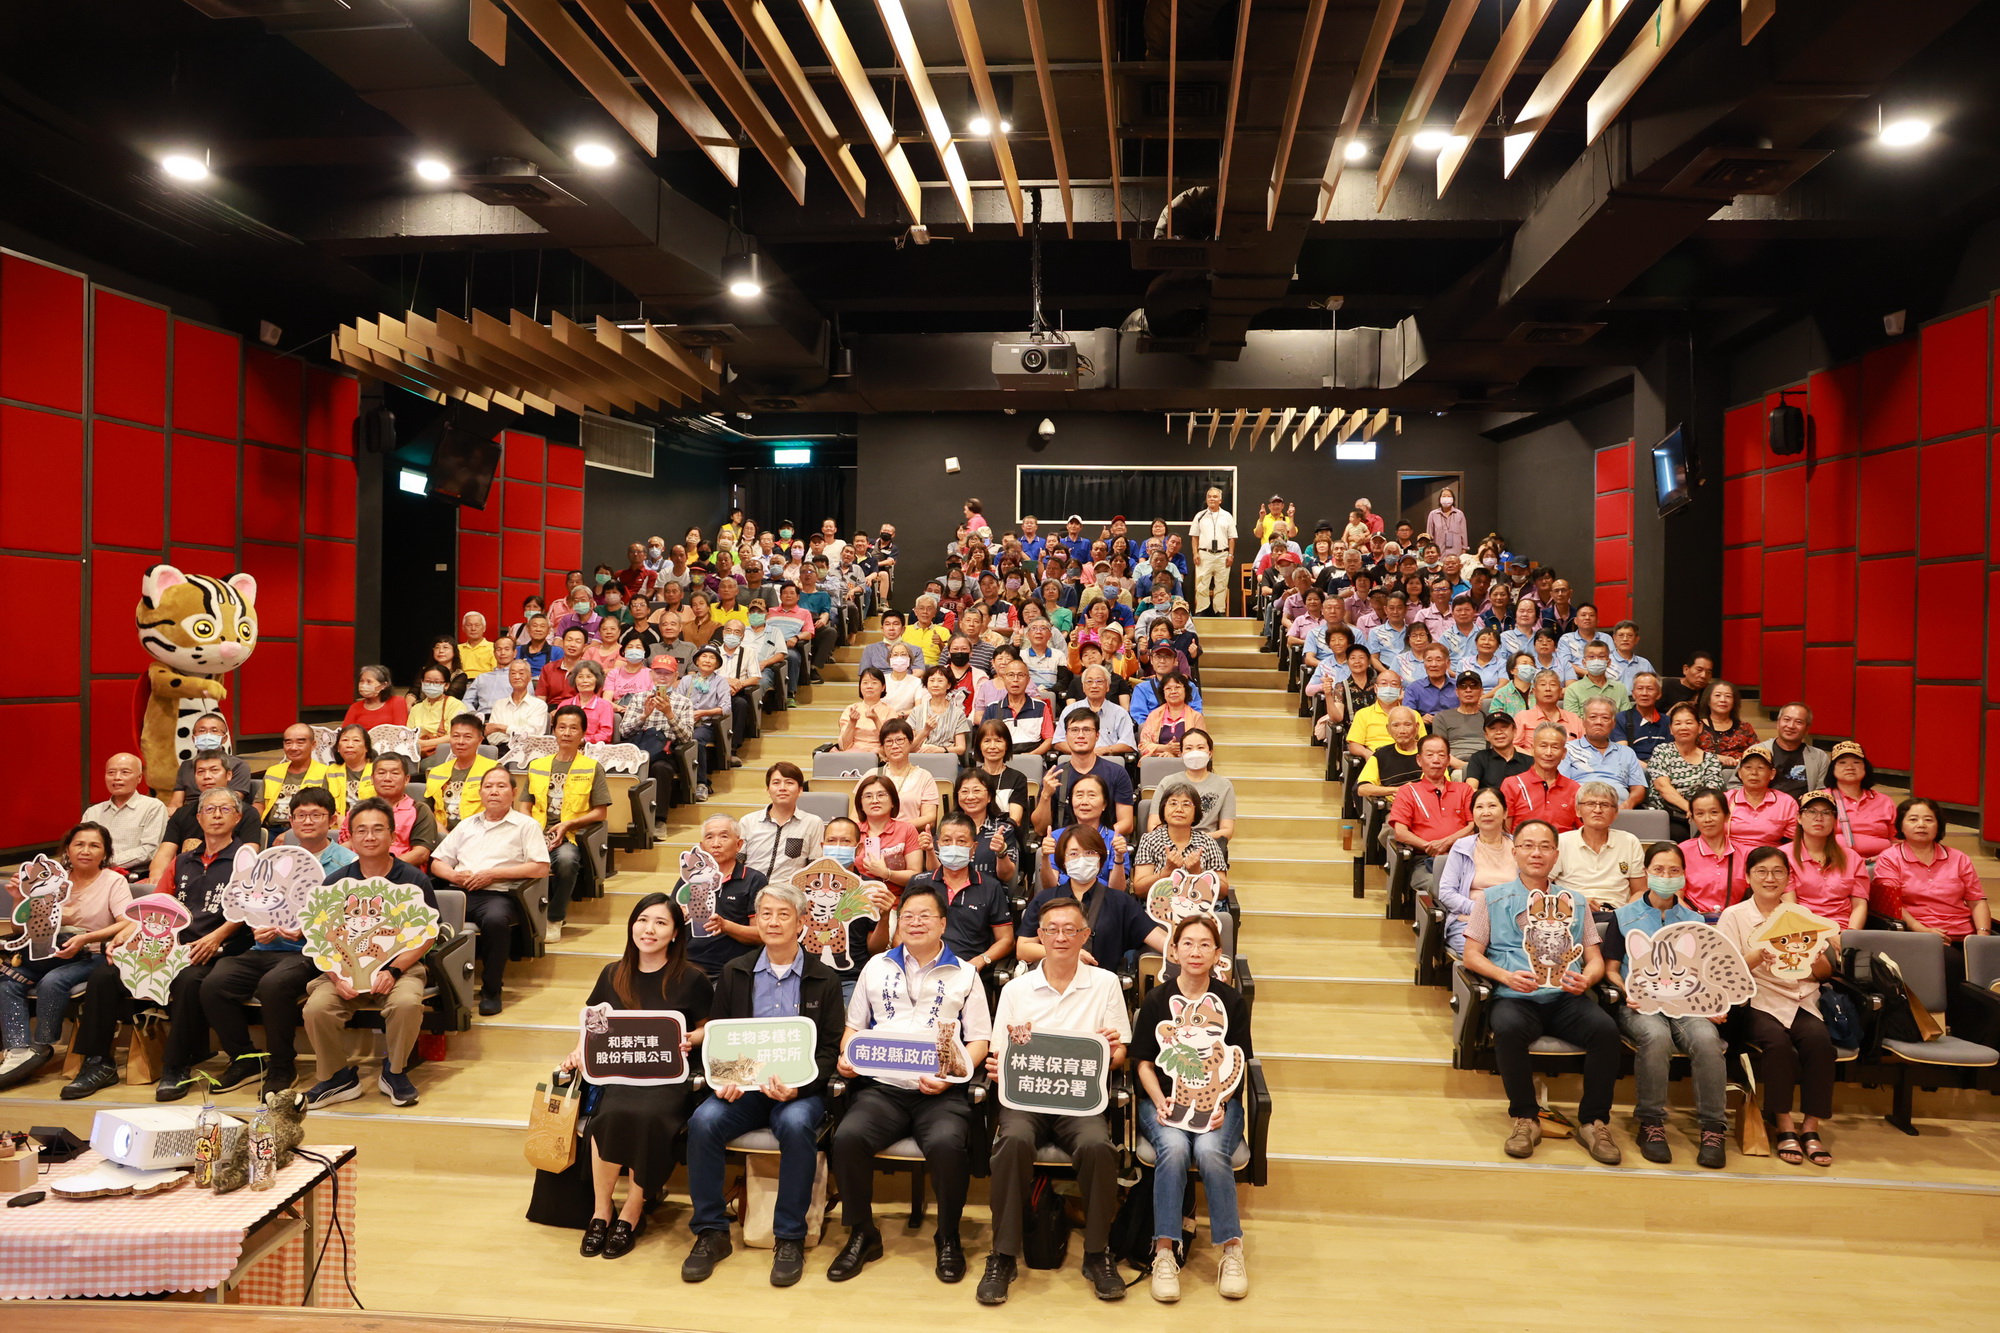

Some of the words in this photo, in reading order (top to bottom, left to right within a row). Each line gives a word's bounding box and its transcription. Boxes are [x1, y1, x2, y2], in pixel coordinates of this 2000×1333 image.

[607, 1035, 660, 1049] 和泰汽車
[727, 1027, 802, 1046] 生物多樣性
[596, 1050, 672, 1065] 股份有限公司
[757, 1047, 802, 1063] 研究所
[855, 1044, 937, 1066] 南投縣政府
[1010, 1053, 1098, 1077] 林業保育署
[1018, 1075, 1087, 1098] 南投分署
